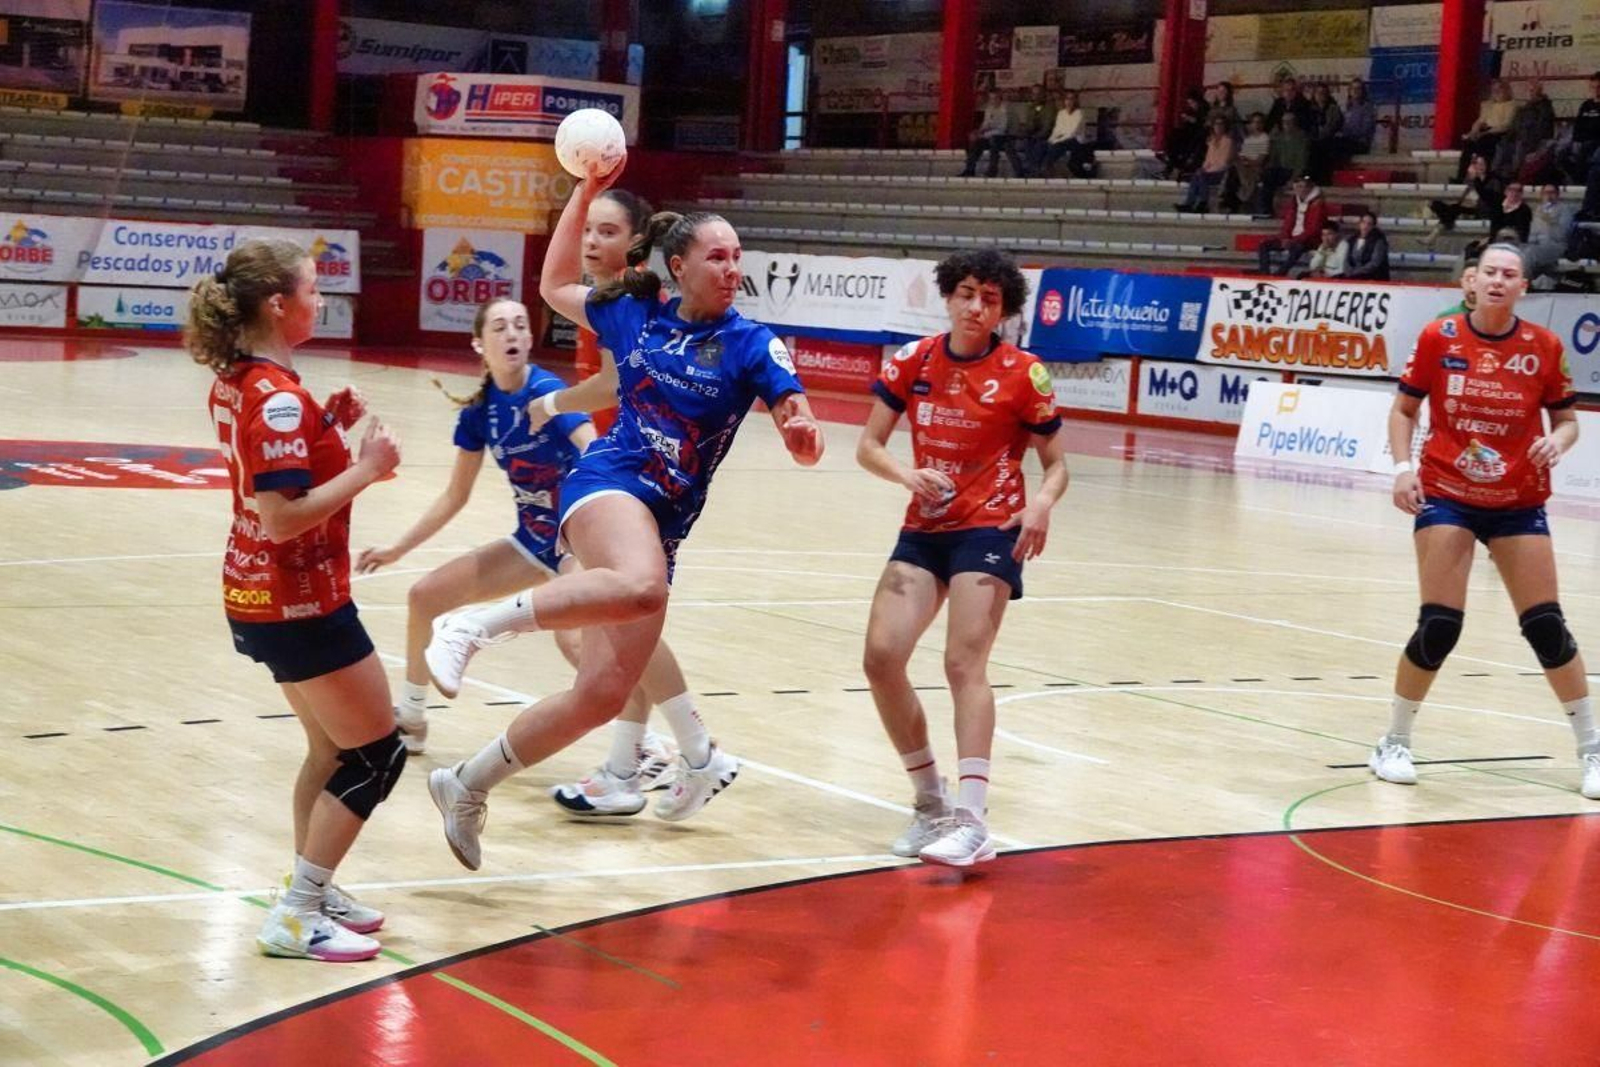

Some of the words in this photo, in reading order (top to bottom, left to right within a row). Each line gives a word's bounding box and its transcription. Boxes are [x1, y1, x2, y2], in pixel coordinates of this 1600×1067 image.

[1496, 32, 1573, 50] Ferreira
[437, 167, 573, 200] CASTRO
[114, 226, 218, 250] Conservas
[77, 250, 173, 273] Pescados
[175, 261, 190, 278] y
[193, 256, 225, 274] Mo
[317, 261, 351, 276] RBE
[427, 276, 513, 304] ORBE
[804, 273, 888, 300] MARCOTE
[131, 301, 173, 316] adoa
[1067, 285, 1170, 327] Natursueño
[1287, 288, 1391, 332] TALLERES
[1211, 322, 1388, 370] SANGUIÑEDA
[1503, 354, 1540, 376] 40
[980, 379, 1000, 404] 2
[1148, 367, 1198, 400] M+Q
[1257, 422, 1358, 458] PipeWorks
